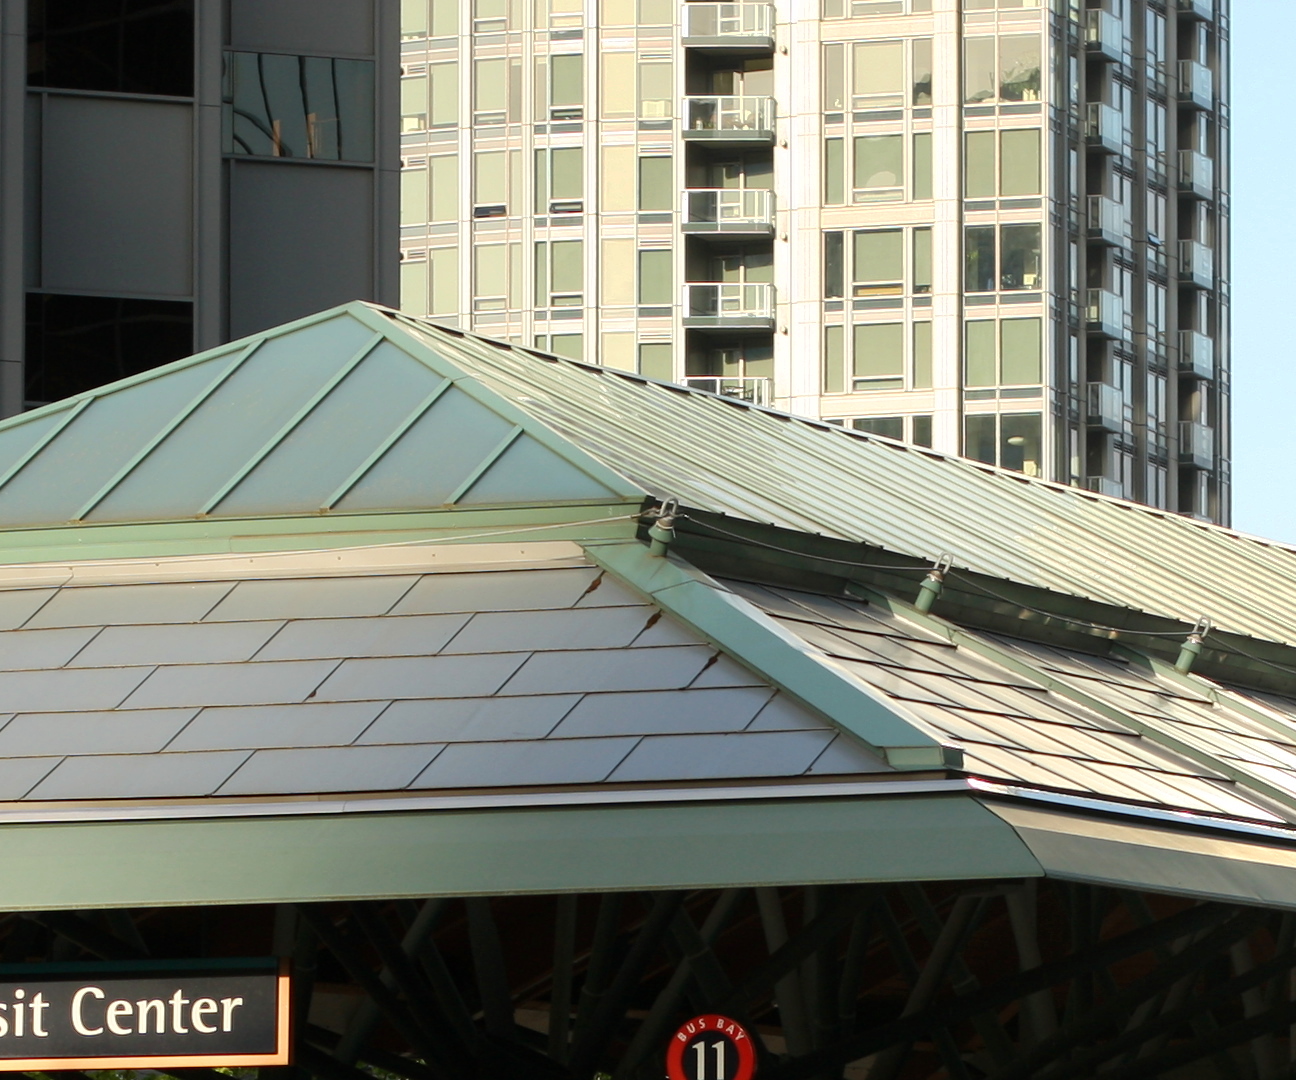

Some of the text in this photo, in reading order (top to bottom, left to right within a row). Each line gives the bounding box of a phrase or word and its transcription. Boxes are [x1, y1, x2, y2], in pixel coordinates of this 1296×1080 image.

[70, 987, 243, 1036] Center
[677, 1018, 745, 1042] BUS BAY
